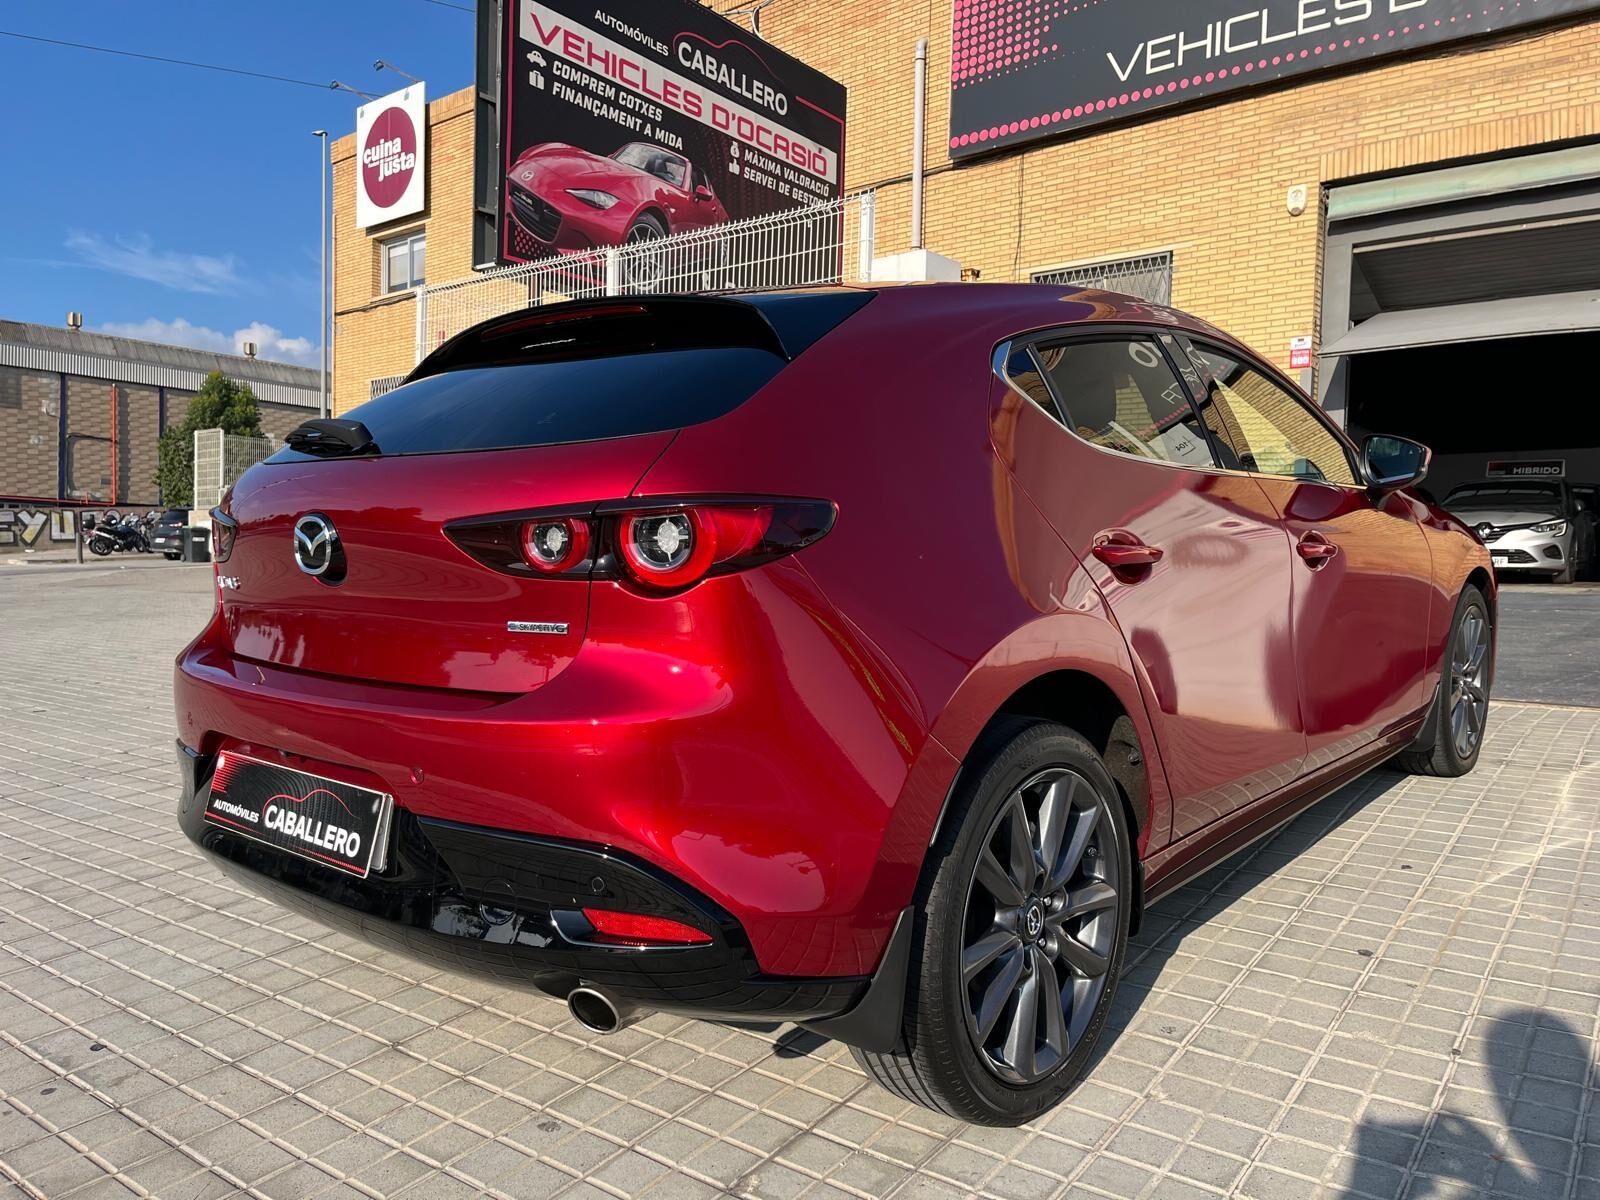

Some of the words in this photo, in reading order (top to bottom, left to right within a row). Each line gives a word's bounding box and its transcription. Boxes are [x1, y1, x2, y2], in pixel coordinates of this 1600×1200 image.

[594, 9, 669, 57] AUTOMÓVILES
[1106, 0, 1372, 81] VEHICLES
[530, 12, 703, 118] VEHICLES
[711, 102, 827, 177] D'OCASIÓ
[552, 60, 616, 100] COMPREM
[618, 91, 663, 122] COTXES
[677, 41, 788, 116] CABALLERO
[552, 82, 643, 132] FINANÇAMENT
[643, 123, 652, 137] A
[655, 127, 683, 151] MIDA
[363, 137, 401, 164] cuina
[378, 151, 415, 182] justa
[744, 149, 781, 176] MÀXIMA
[783, 166, 829, 197] VALORACIÓ
[743, 166, 777, 190] SERVEI
[778, 181, 790, 196] DE
[792, 187, 825, 209] GESTOR
[1513, 466, 1560, 475] HIBRIDO
[213, 799, 260, 823] AUTOMÓVILES
[264, 804, 361, 858] CABALLERO
